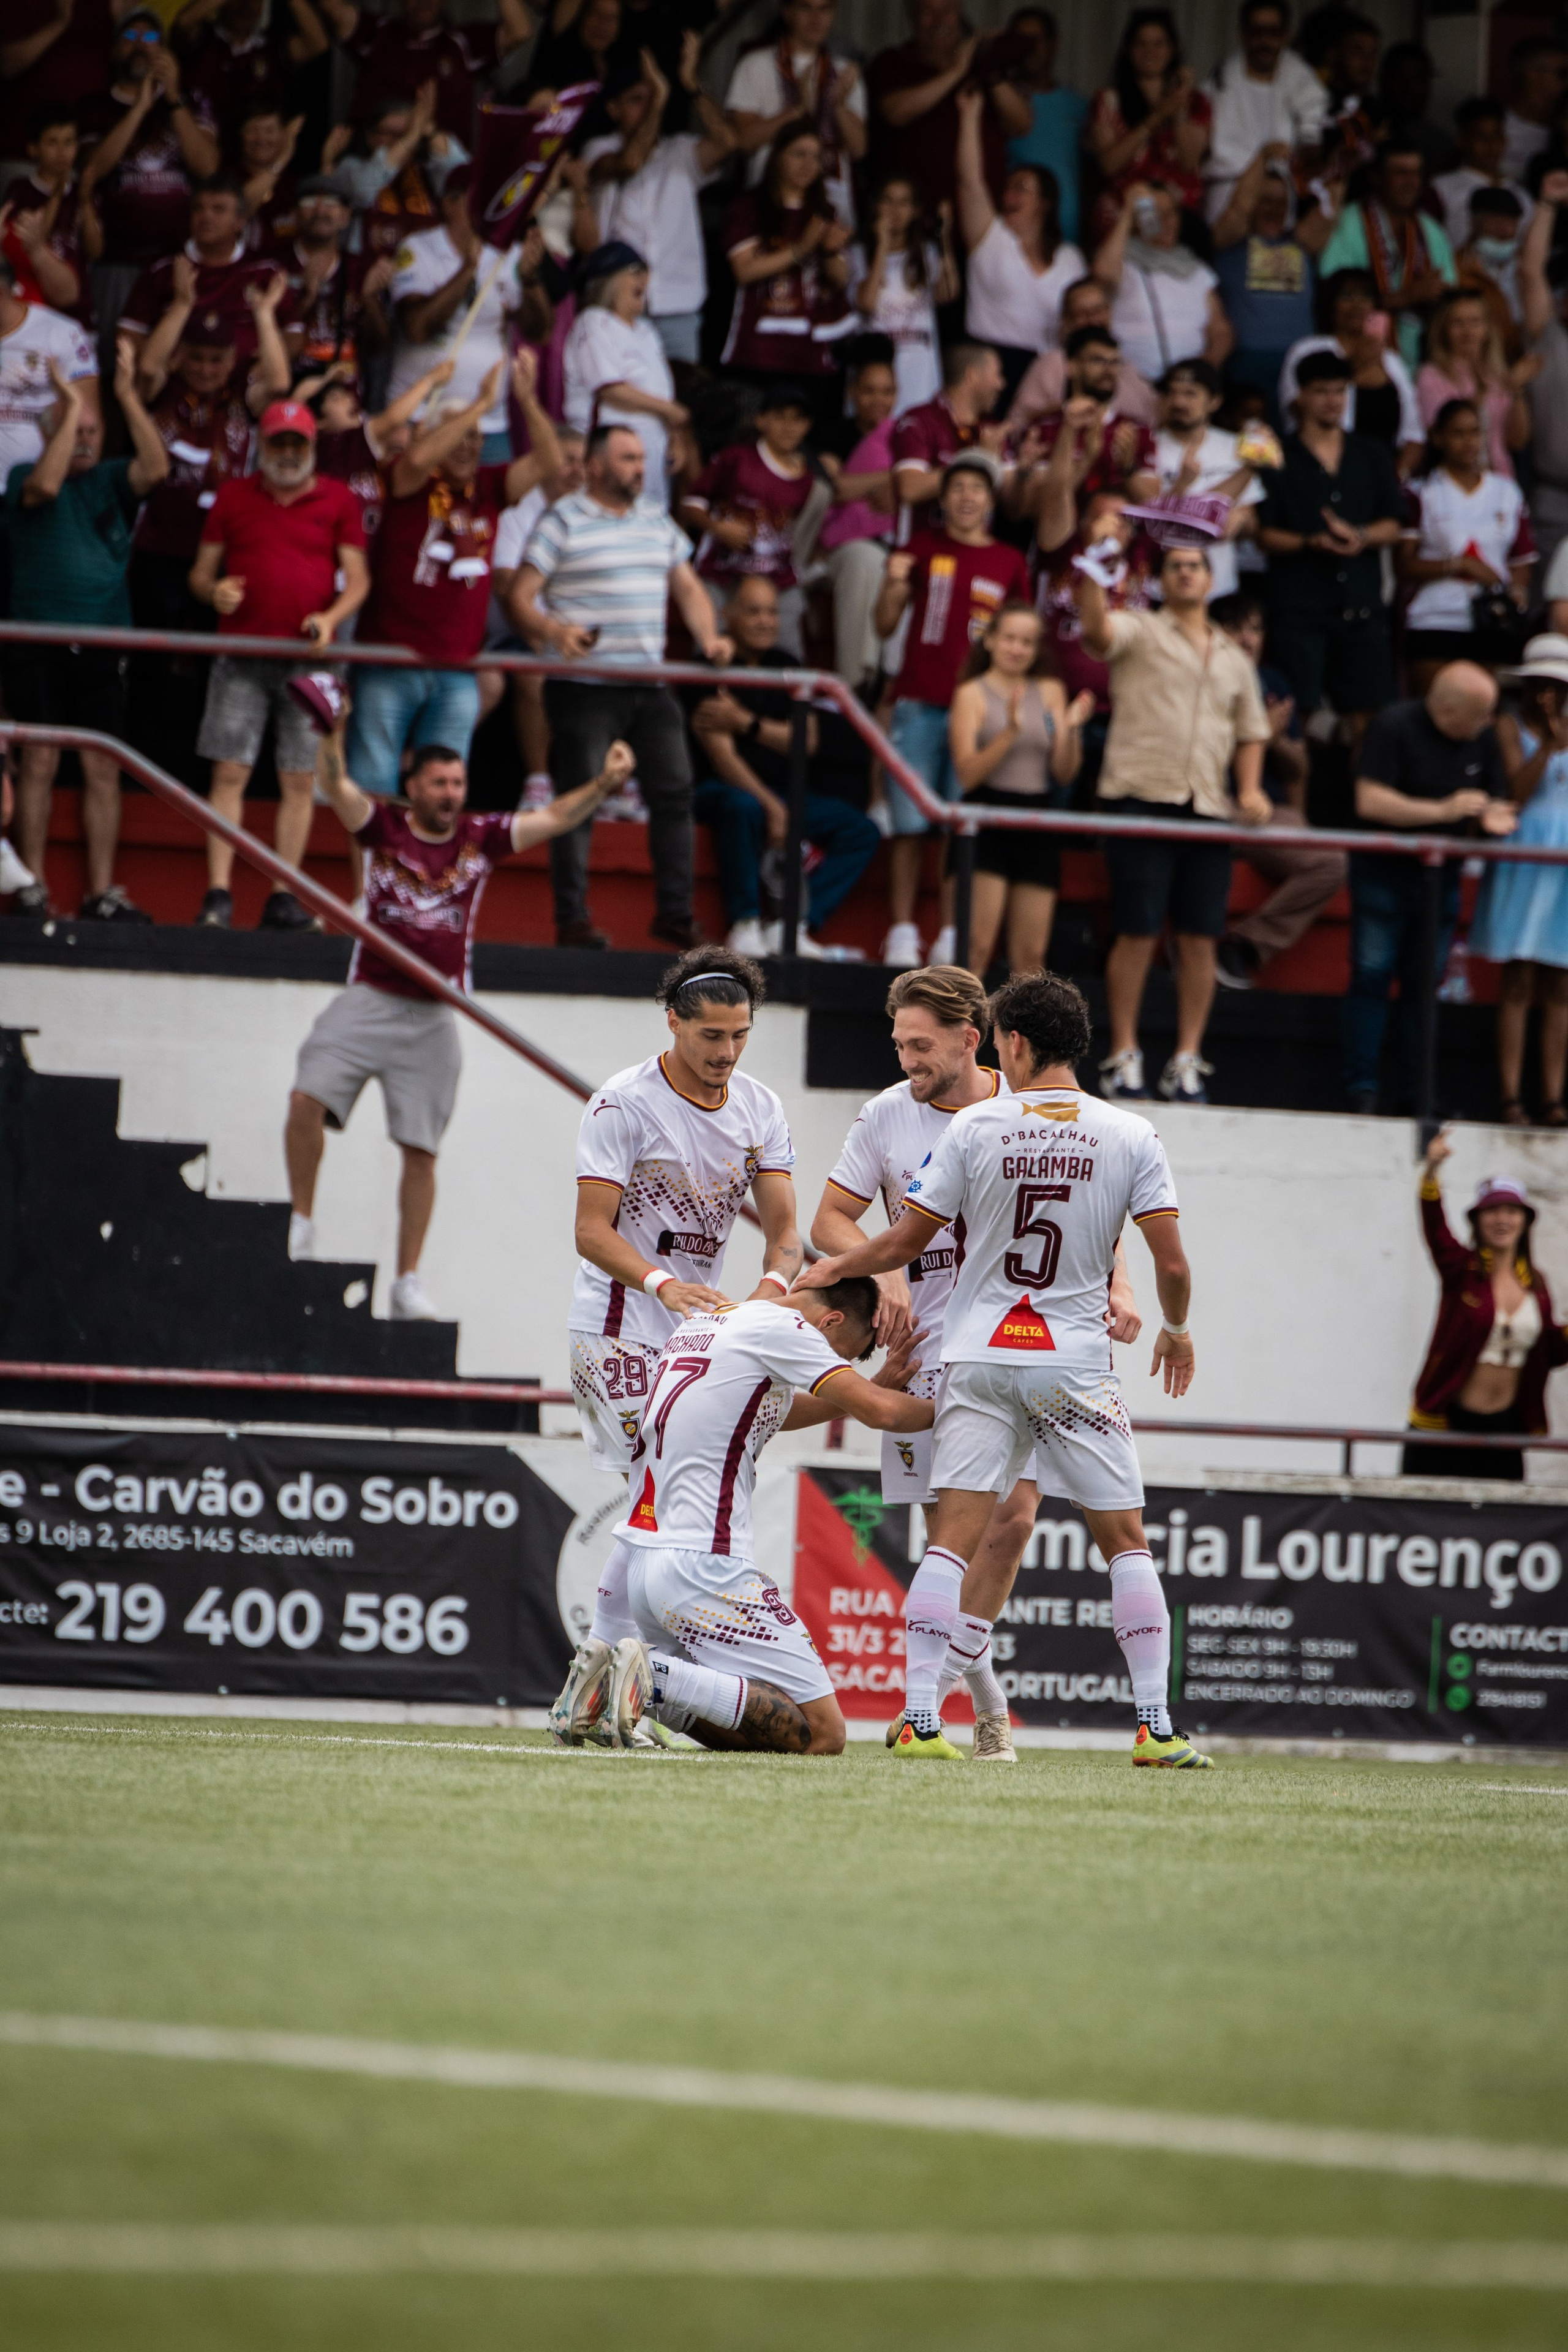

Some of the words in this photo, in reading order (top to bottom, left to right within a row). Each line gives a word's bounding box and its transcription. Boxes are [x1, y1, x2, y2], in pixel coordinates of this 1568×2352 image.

[1001, 1129, 1099, 1147] D'BACALHAU
[1002, 1156, 1094, 1182] GALAMBA
[687, 1236, 703, 1251] DO
[1004, 1184, 1071, 1290] 5
[920, 1253, 940, 1270] RUI
[943, 1251, 954, 1268] D
[1003, 1324, 1044, 1336] DELTA
[603, 1355, 647, 1400] 29
[75, 1463, 265, 1518] Carvão
[276, 1471, 348, 1523] do
[360, 1475, 519, 1529] Sobro
[15, 1518, 34, 1544] 9
[39, 1518, 92, 1551] Loja
[96, 1521, 119, 1551] 2,
[123, 1523, 235, 1553] 2685-145
[239, 1526, 355, 1559] Sacavém
[1240, 1515, 1562, 1610] Lourenço
[0, 1598, 49, 1625] cte:
[54, 1579, 167, 1644] 219
[184, 1586, 323, 1649] 400
[339, 1594, 470, 1657] 586
[829, 1586, 896, 1618] RUA
[1076, 1597, 1114, 1628] RE
[1187, 1601, 1295, 1630] HORÁRIO
[1117, 1626, 1163, 1645] PLAYOFF
[1449, 1622, 1568, 1653] CONTACT
[993, 1669, 1135, 1704] ORTUGAL
[1184, 1681, 1295, 1703] ENCERRADO
[1295, 1684, 1325, 1705] AO
[1325, 1686, 1416, 1709] DOMINGO
